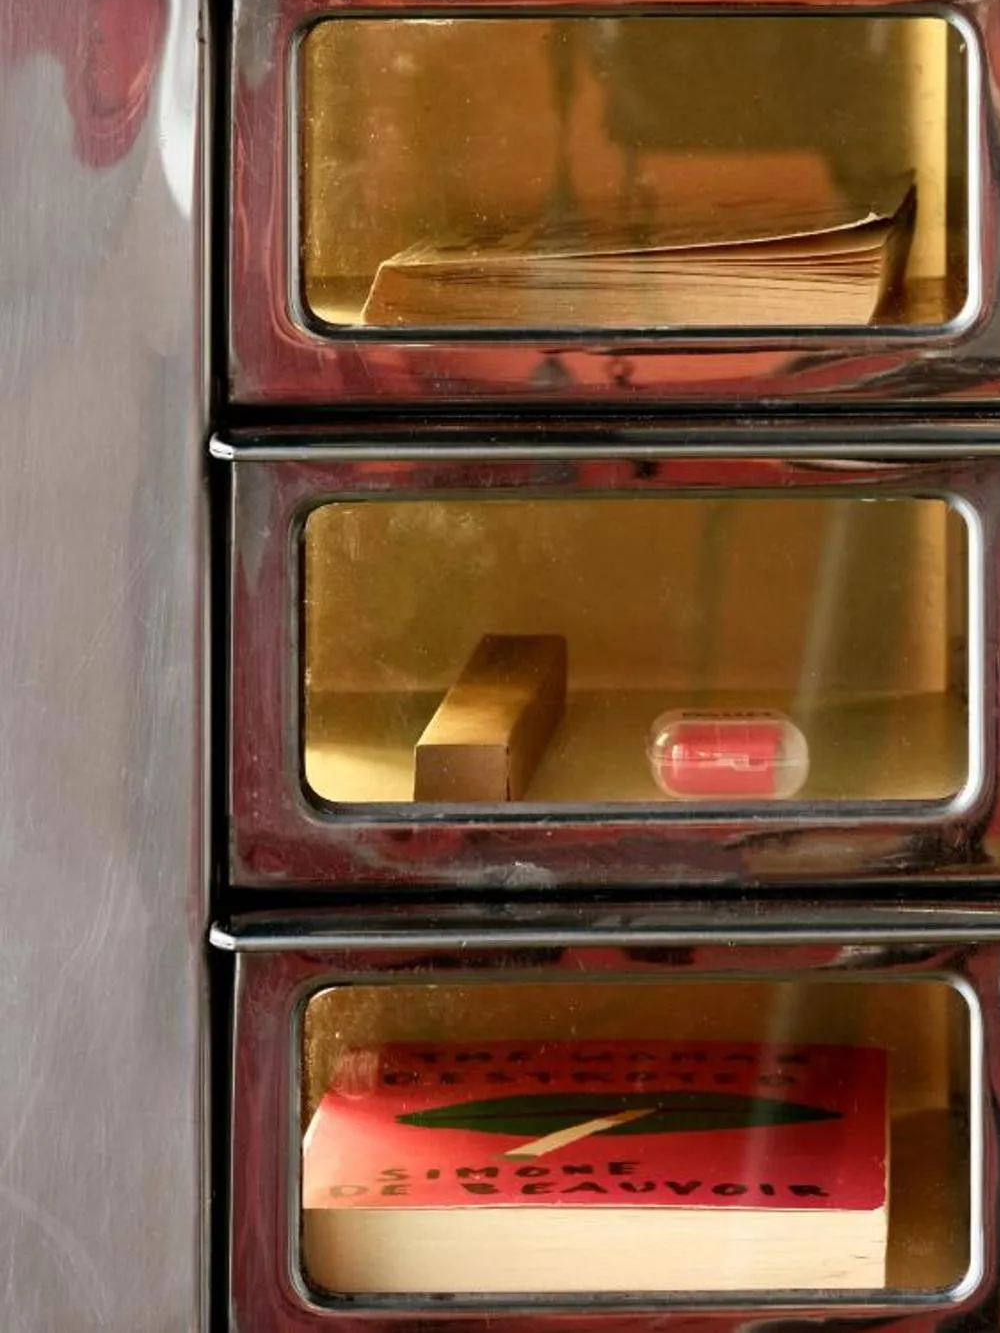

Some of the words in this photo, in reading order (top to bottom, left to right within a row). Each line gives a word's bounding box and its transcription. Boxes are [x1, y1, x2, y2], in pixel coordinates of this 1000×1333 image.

[376, 1160, 642, 1183] SIMONE
[327, 1183, 412, 1198] DE
[460, 1180, 831, 1197] BEAUVOIR
